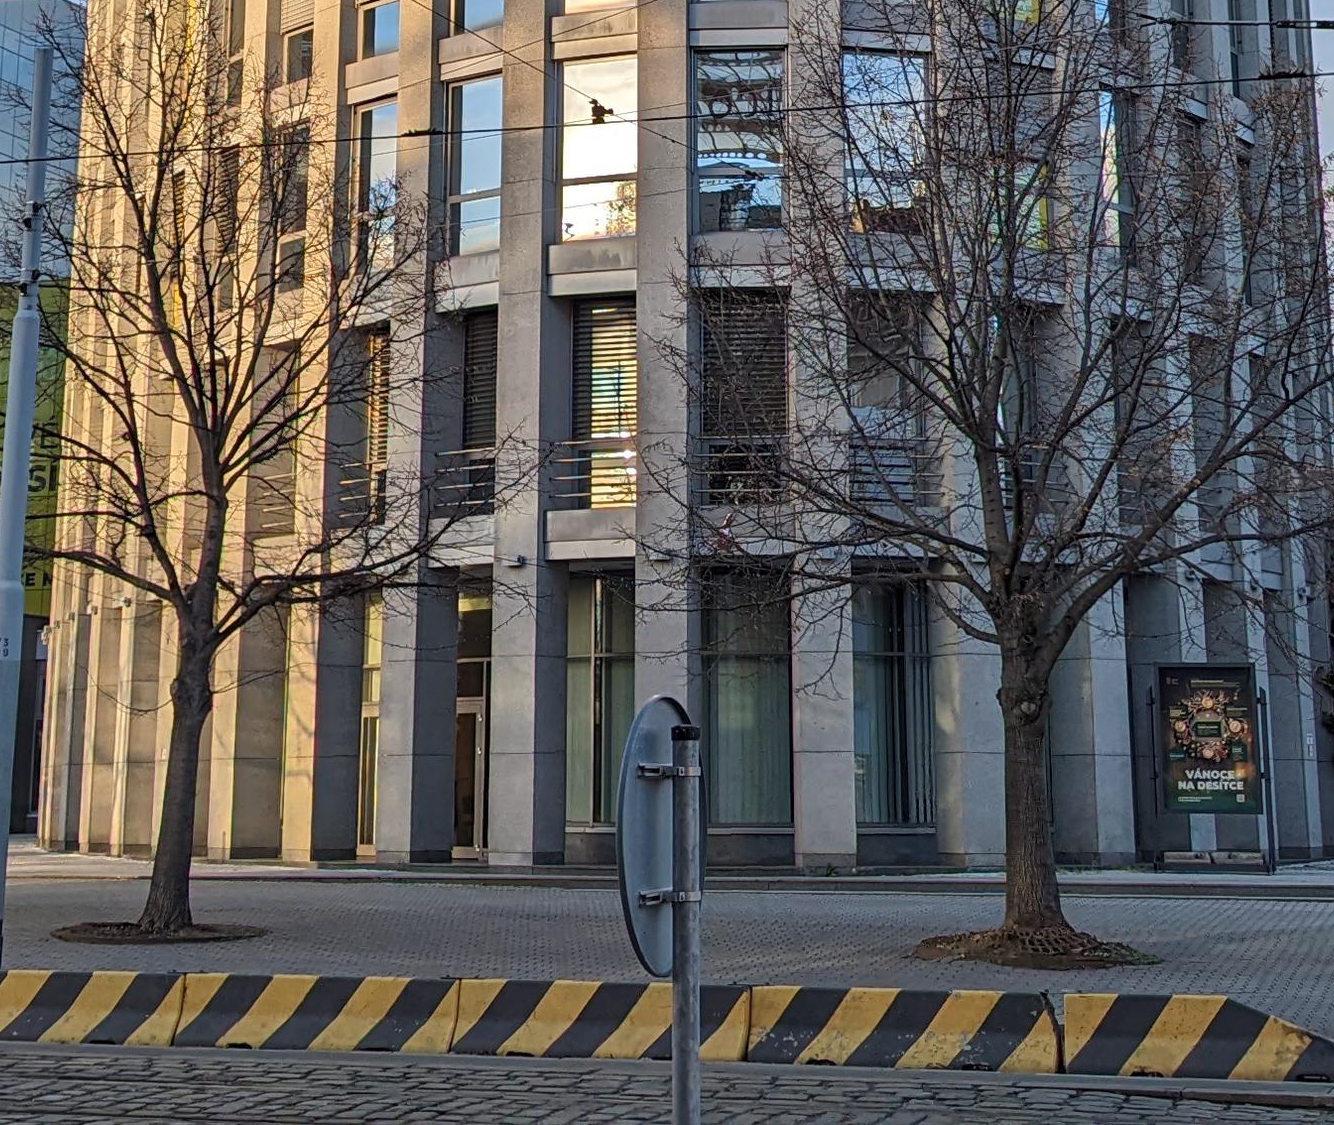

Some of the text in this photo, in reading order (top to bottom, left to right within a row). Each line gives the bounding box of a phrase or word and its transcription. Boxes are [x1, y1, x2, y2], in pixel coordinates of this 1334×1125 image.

[1185, 768, 1235, 779] VÁNOCE
[1178, 779, 1244, 790] NA DESÍTCE
